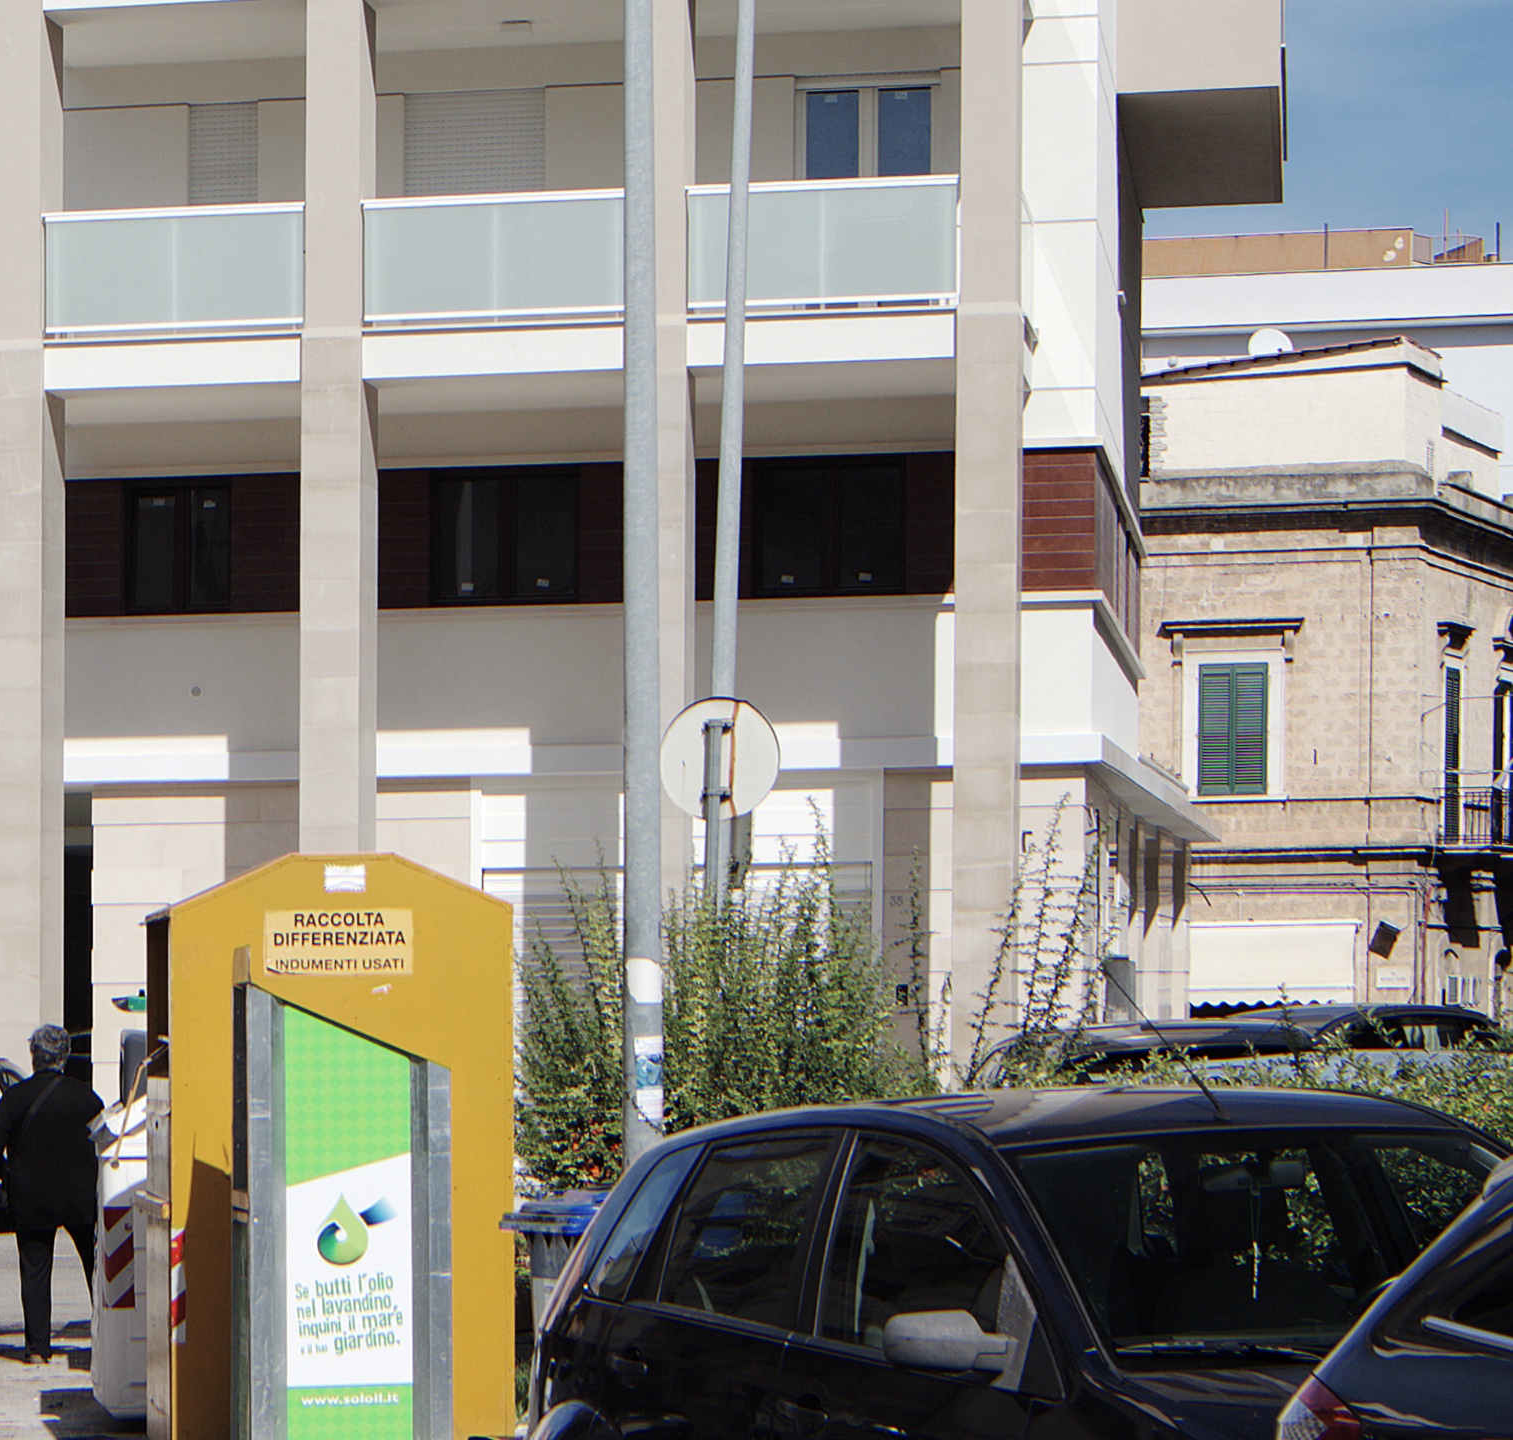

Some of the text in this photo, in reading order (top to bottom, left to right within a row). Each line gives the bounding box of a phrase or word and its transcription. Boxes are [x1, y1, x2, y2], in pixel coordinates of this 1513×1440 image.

[293, 912, 384, 927] RACCOLTA
[273, 930, 406, 946] DIFFERENZIATA
[275, 958, 404, 970] INDUMENTI USATI
[295, 1283, 309, 1299] Se
[315, 1275, 352, 1298] butti
[297, 1292, 397, 1319] nel lavandino,
[298, 1310, 403, 1339] inquini il mare
[334, 1328, 400, 1355] giardino.
[301, 1392, 400, 1406] www.soloil.it
